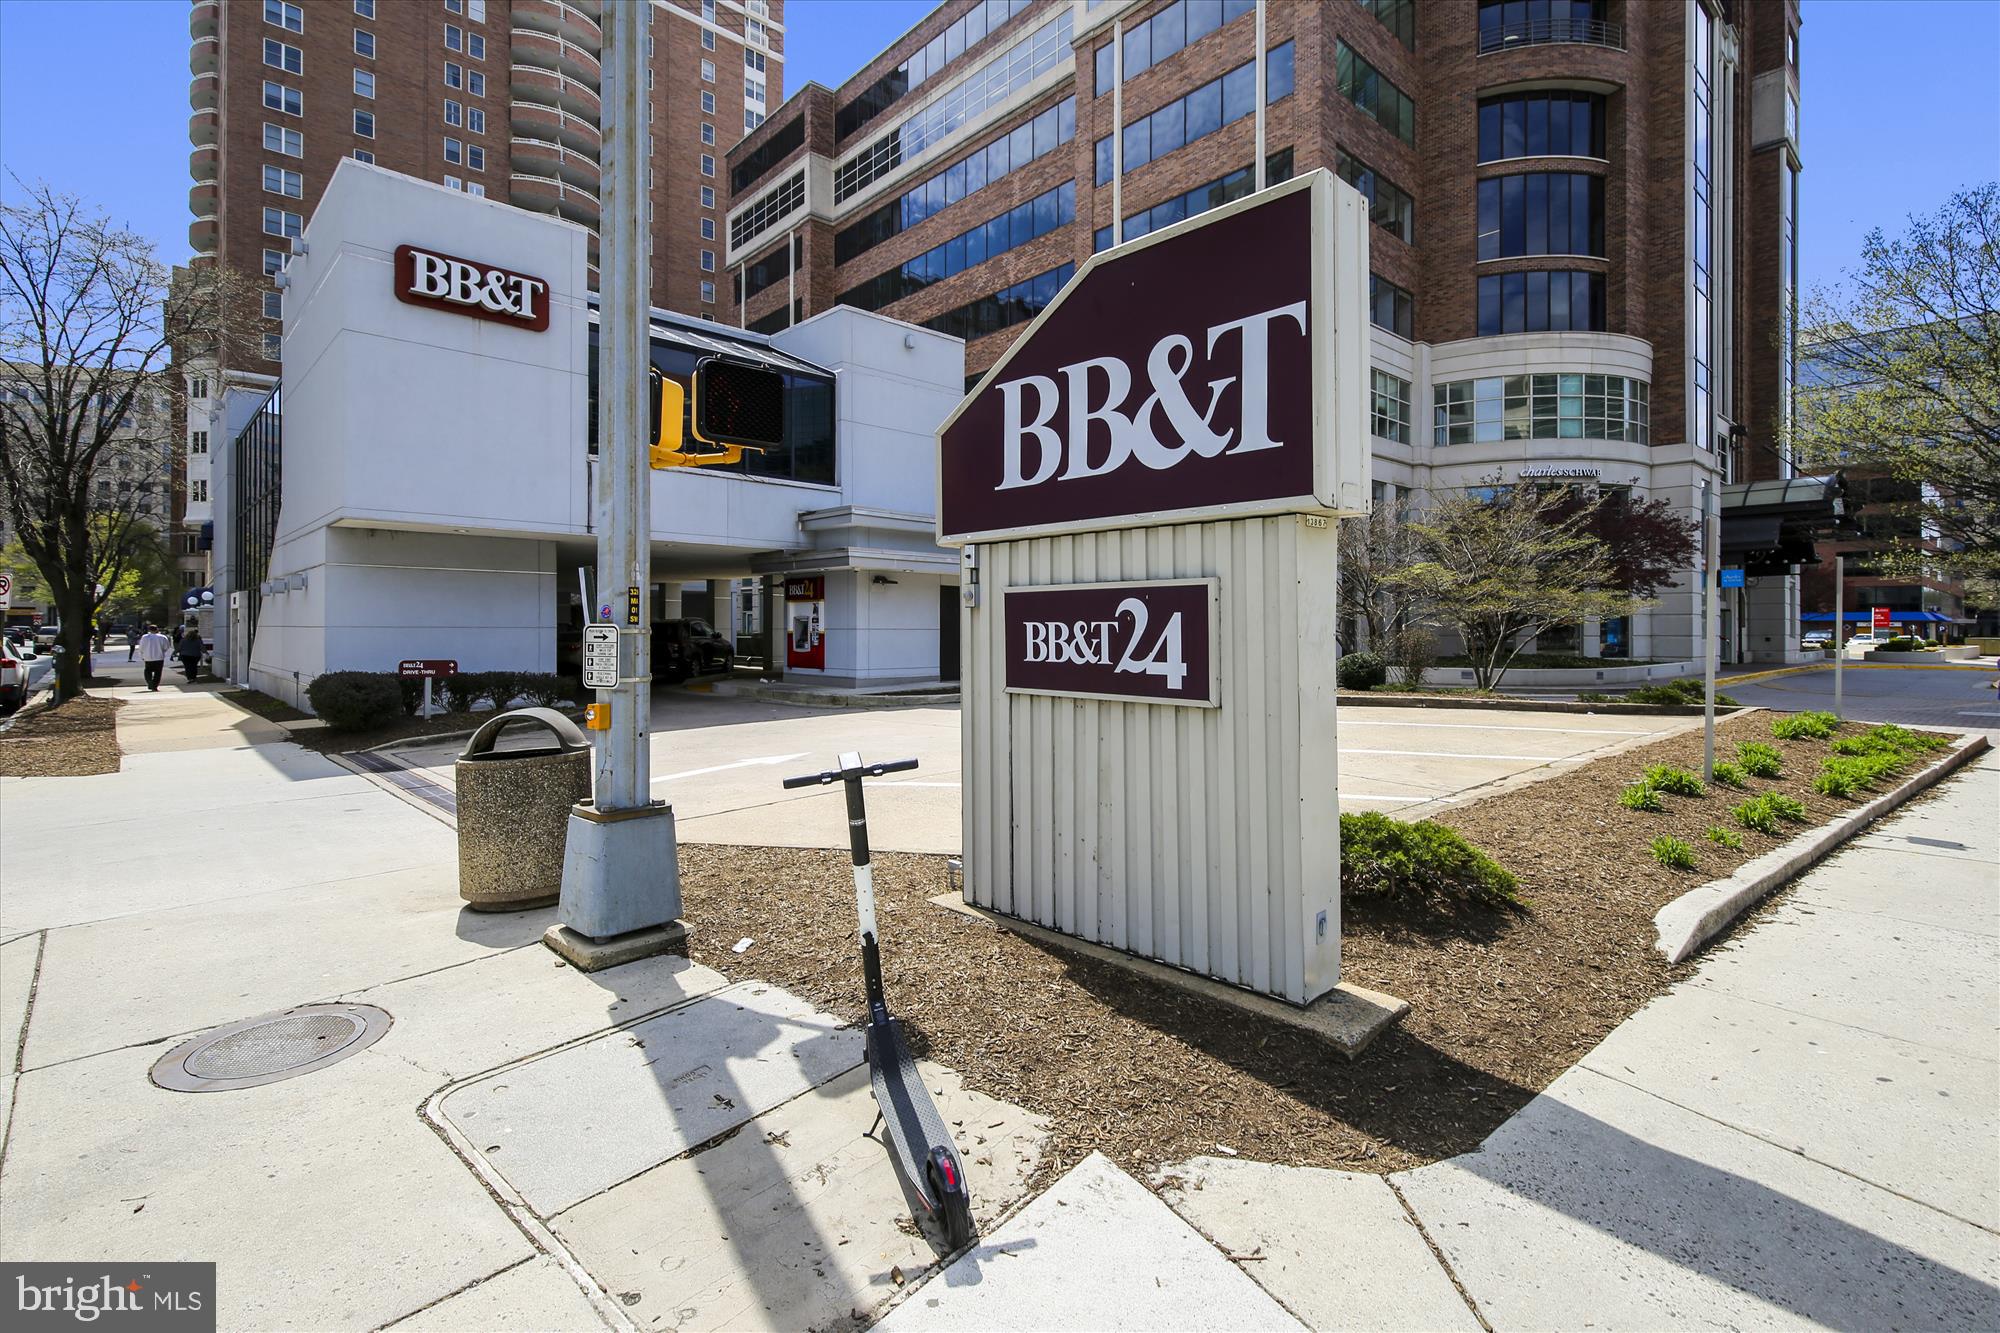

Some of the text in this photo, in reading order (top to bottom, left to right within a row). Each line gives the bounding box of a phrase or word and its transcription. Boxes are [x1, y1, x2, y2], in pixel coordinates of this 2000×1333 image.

[409, 251, 543, 320] BB&T
[995, 301, 1306, 490] BB&T
[1520, 465, 1561, 477] charles
[1023, 597, 1187, 690] BB&T24
